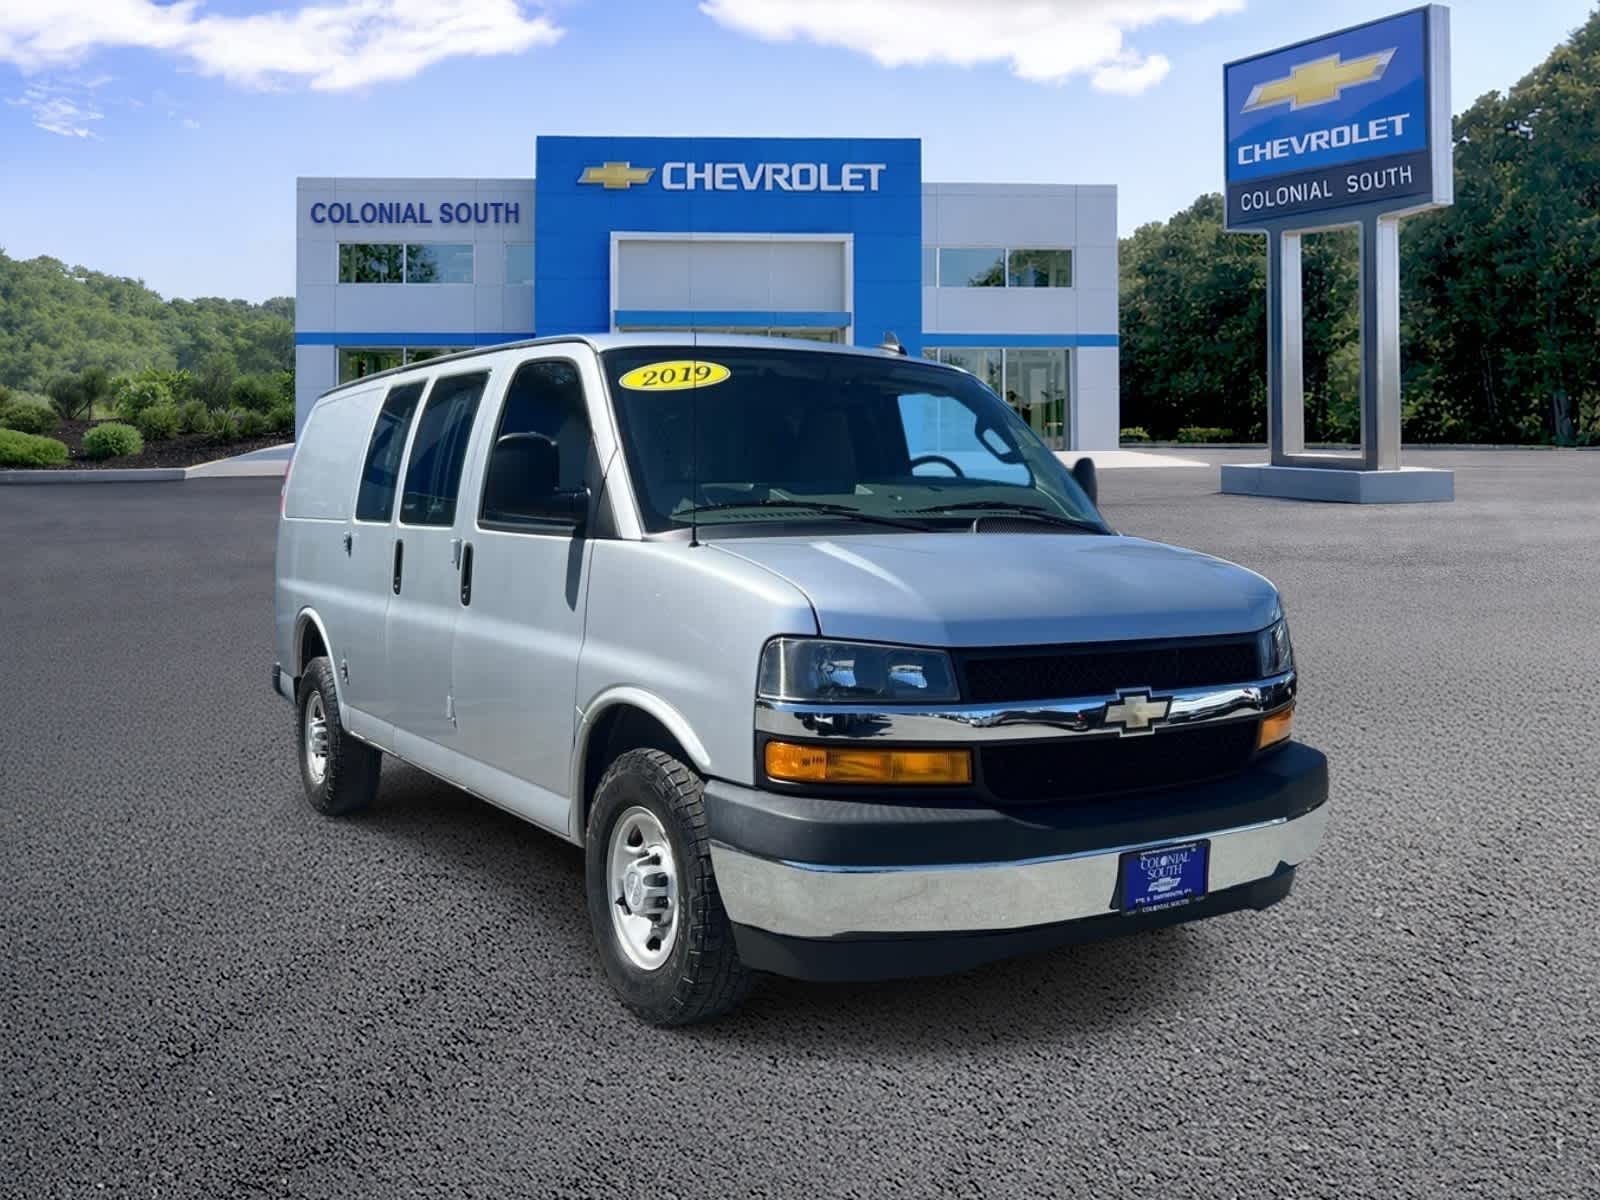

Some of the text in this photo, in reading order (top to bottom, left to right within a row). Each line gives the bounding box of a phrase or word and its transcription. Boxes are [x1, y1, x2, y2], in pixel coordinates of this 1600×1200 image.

[1237, 112, 1410, 165] CHEVROLET
[662, 162, 887, 191] CHEVROLET
[1240, 165, 1413, 211] COLONIAL SOUTH
[310, 202, 520, 224] COLONIAL SOUTH
[642, 365, 712, 386] 2019
[1140, 852, 1190, 870] COLONIAL
[1147, 864, 1182, 880] SOUTH
